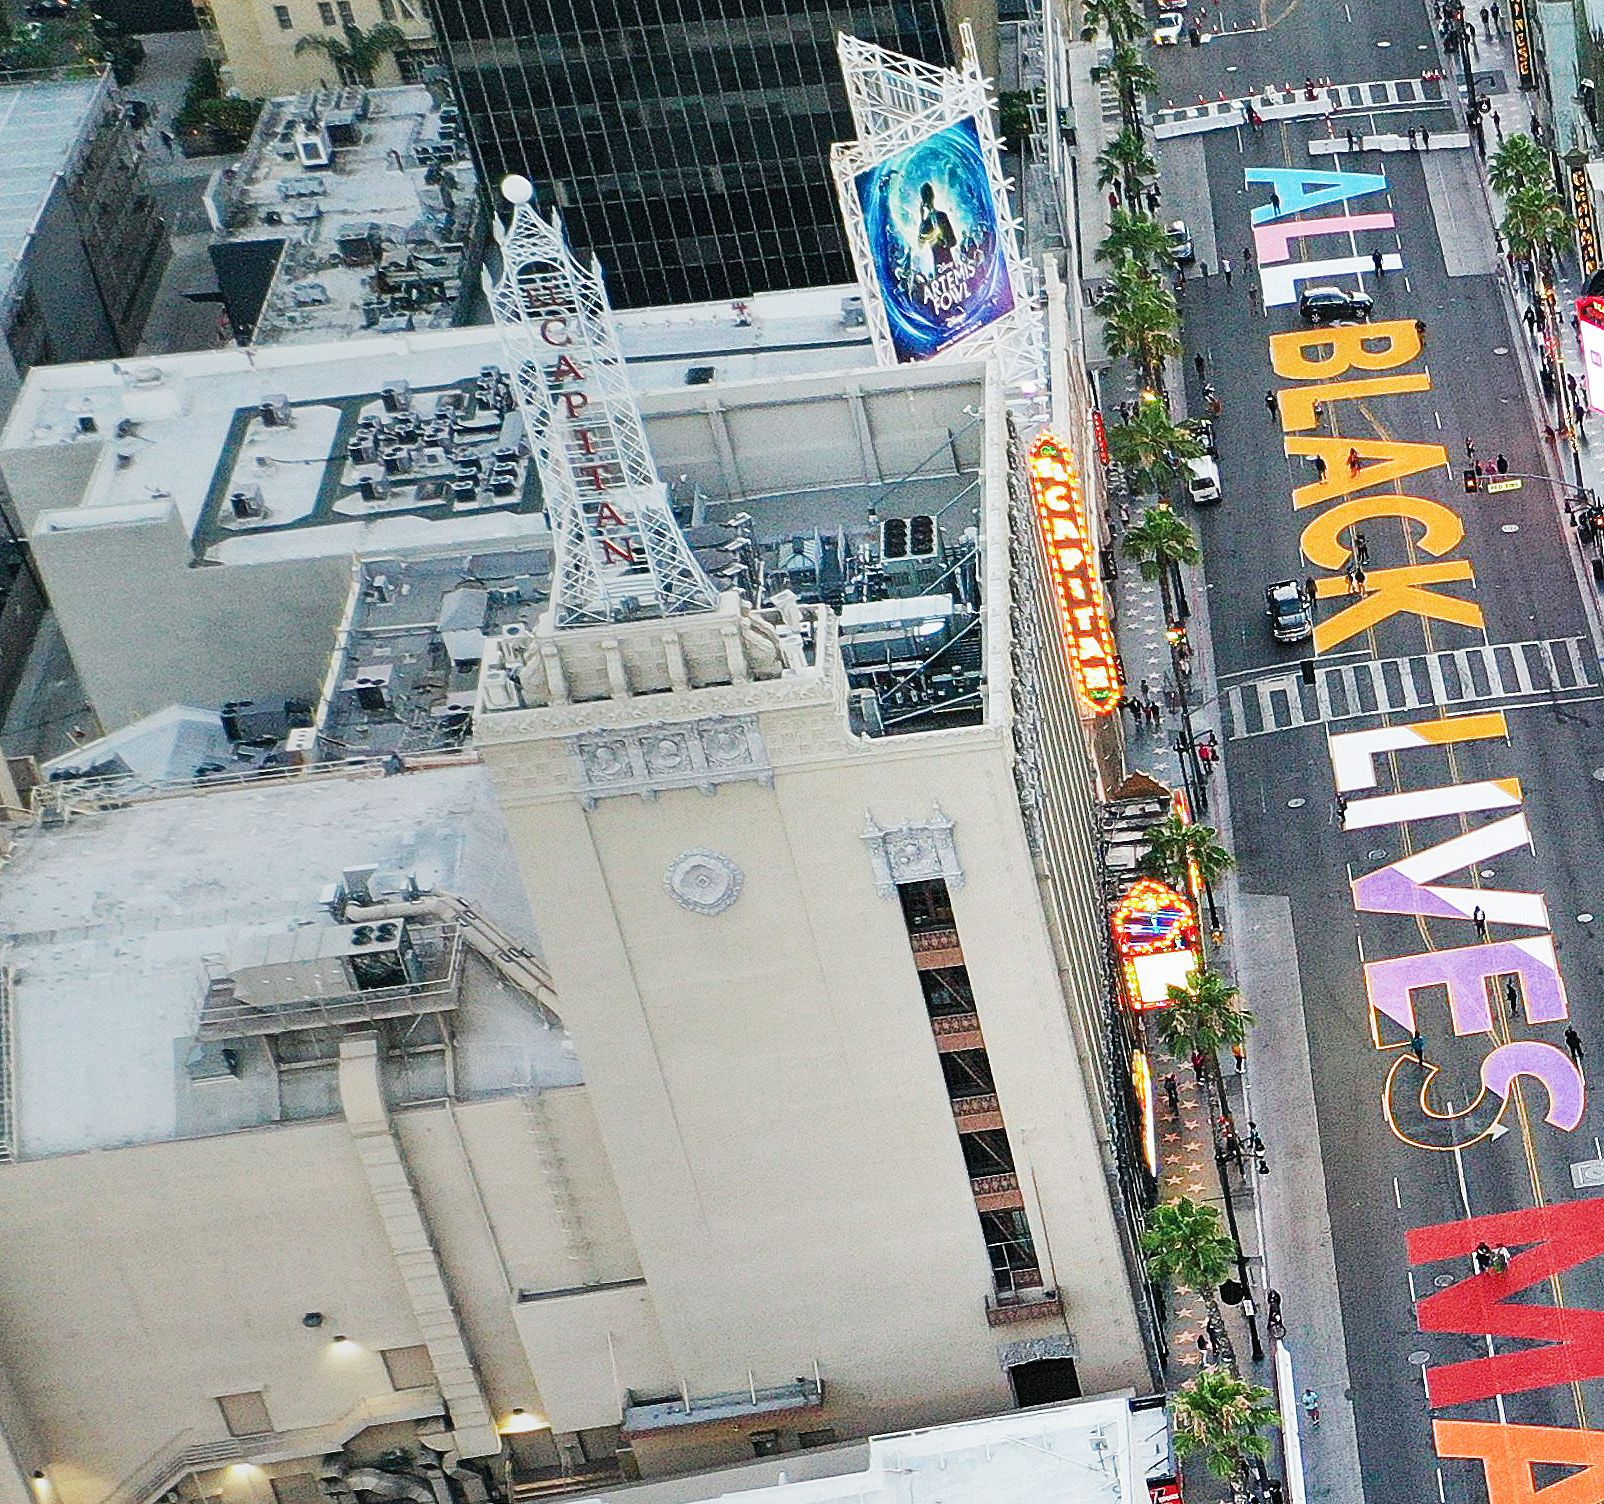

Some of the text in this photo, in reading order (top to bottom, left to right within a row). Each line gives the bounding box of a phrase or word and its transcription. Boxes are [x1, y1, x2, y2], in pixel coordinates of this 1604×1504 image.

[922, 259, 976, 305] ARTEMIS
[932, 281, 972, 316] FOWL
[1244, 167, 1404, 307] ALL
[539, 316, 638, 565] CAPITAN
[1269, 319, 1485, 655] BLACK
[1043, 483, 1110, 690] CAPITAN
[1330, 711, 1586, 1151] LIVES
